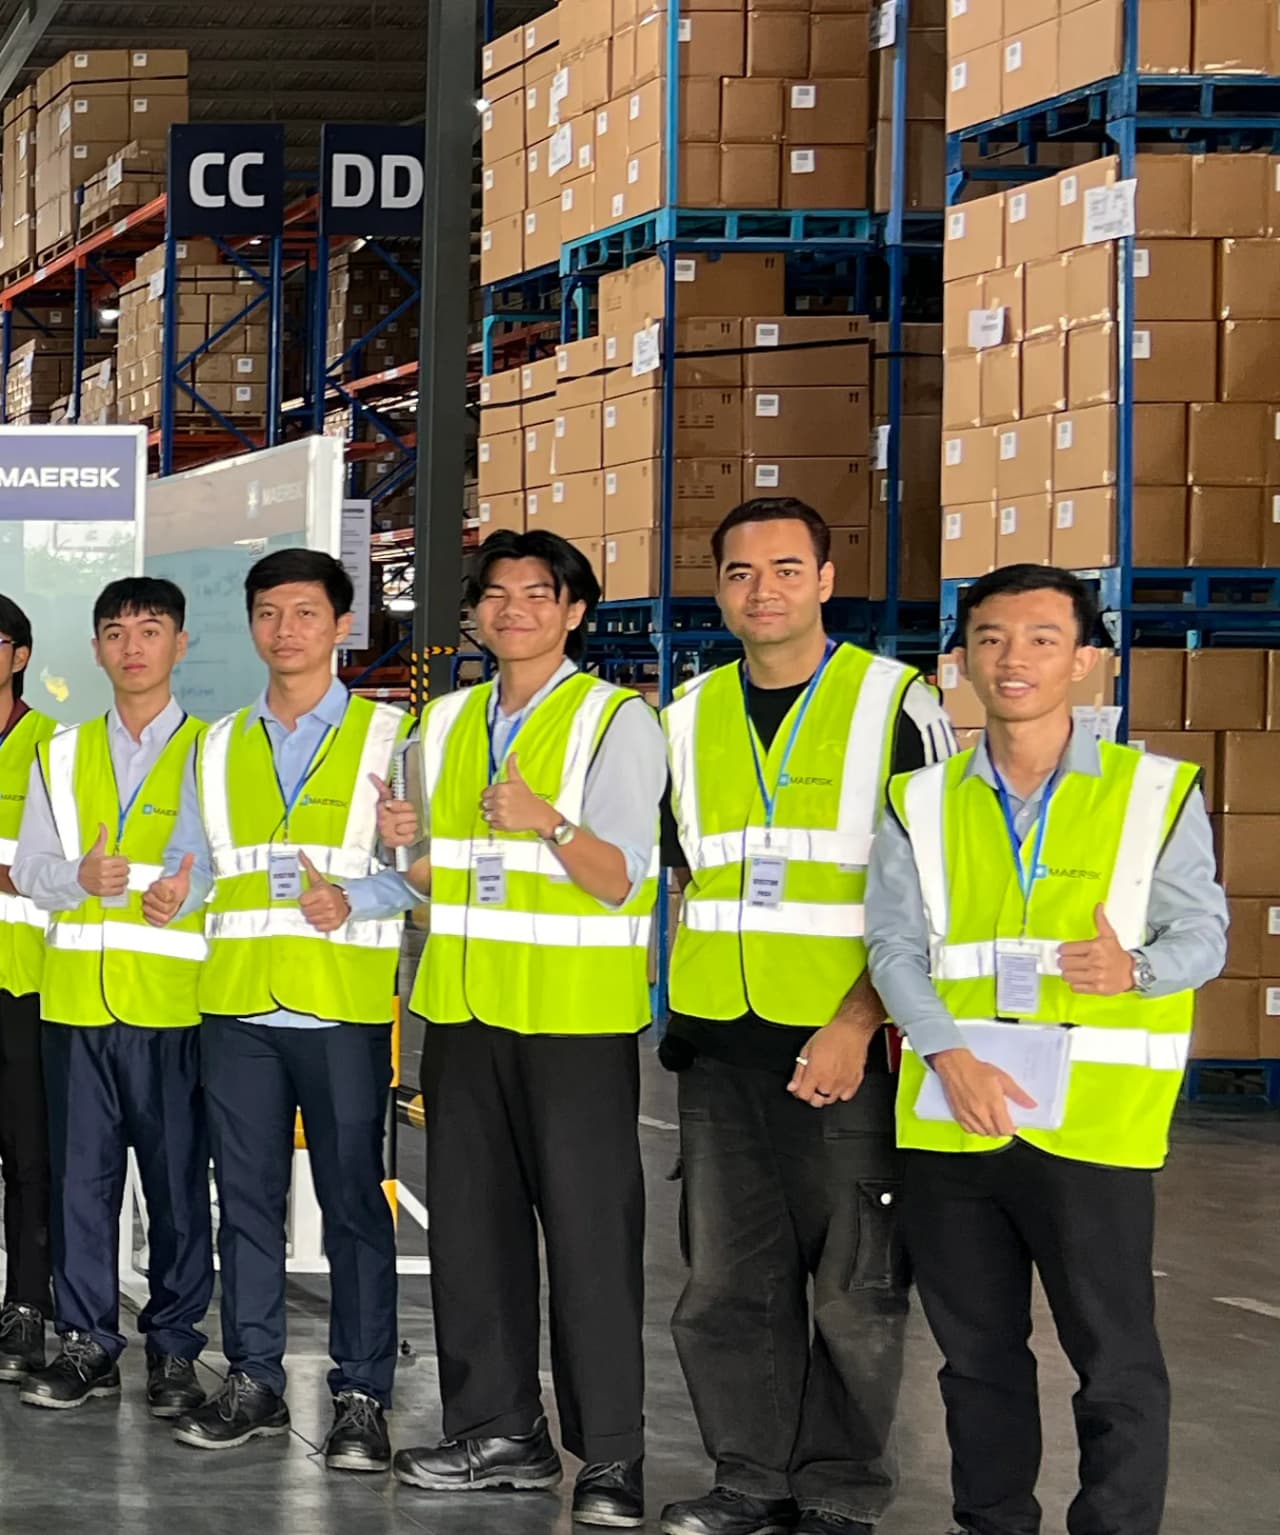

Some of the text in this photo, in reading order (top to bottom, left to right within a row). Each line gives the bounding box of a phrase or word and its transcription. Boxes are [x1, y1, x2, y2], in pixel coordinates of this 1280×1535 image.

[189, 152, 265, 208] CC
[331, 153, 424, 209] DD
[790, 776, 833, 786] MAERSK
[1049, 867, 1101, 880] MAERSK
